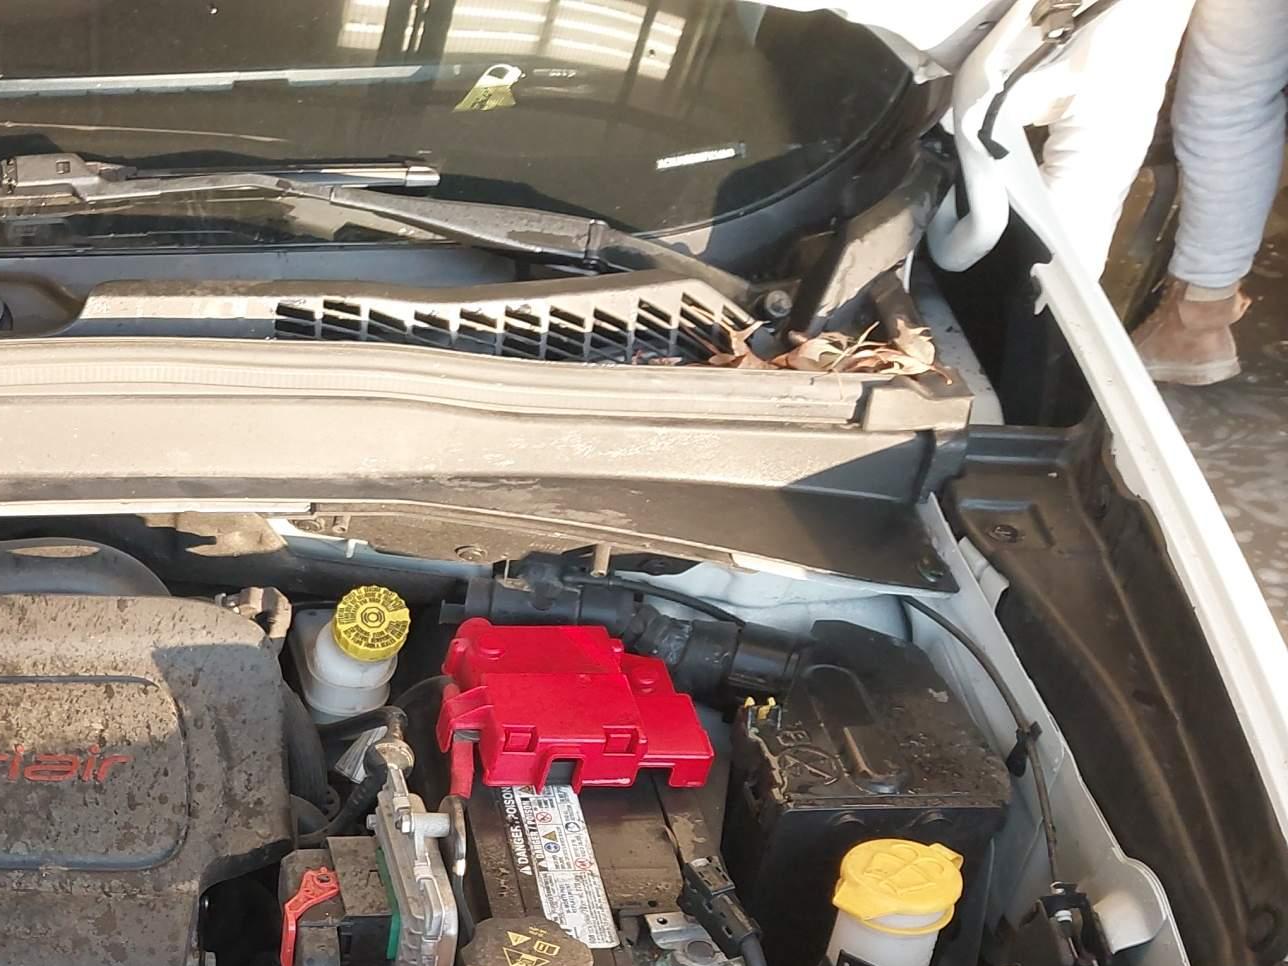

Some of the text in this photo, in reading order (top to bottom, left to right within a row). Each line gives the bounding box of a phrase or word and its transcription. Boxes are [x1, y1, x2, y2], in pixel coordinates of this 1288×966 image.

[521, 799, 536, 825] POISON
[509, 826, 529, 865] DANGER
[529, 831, 545, 859] DANGER
